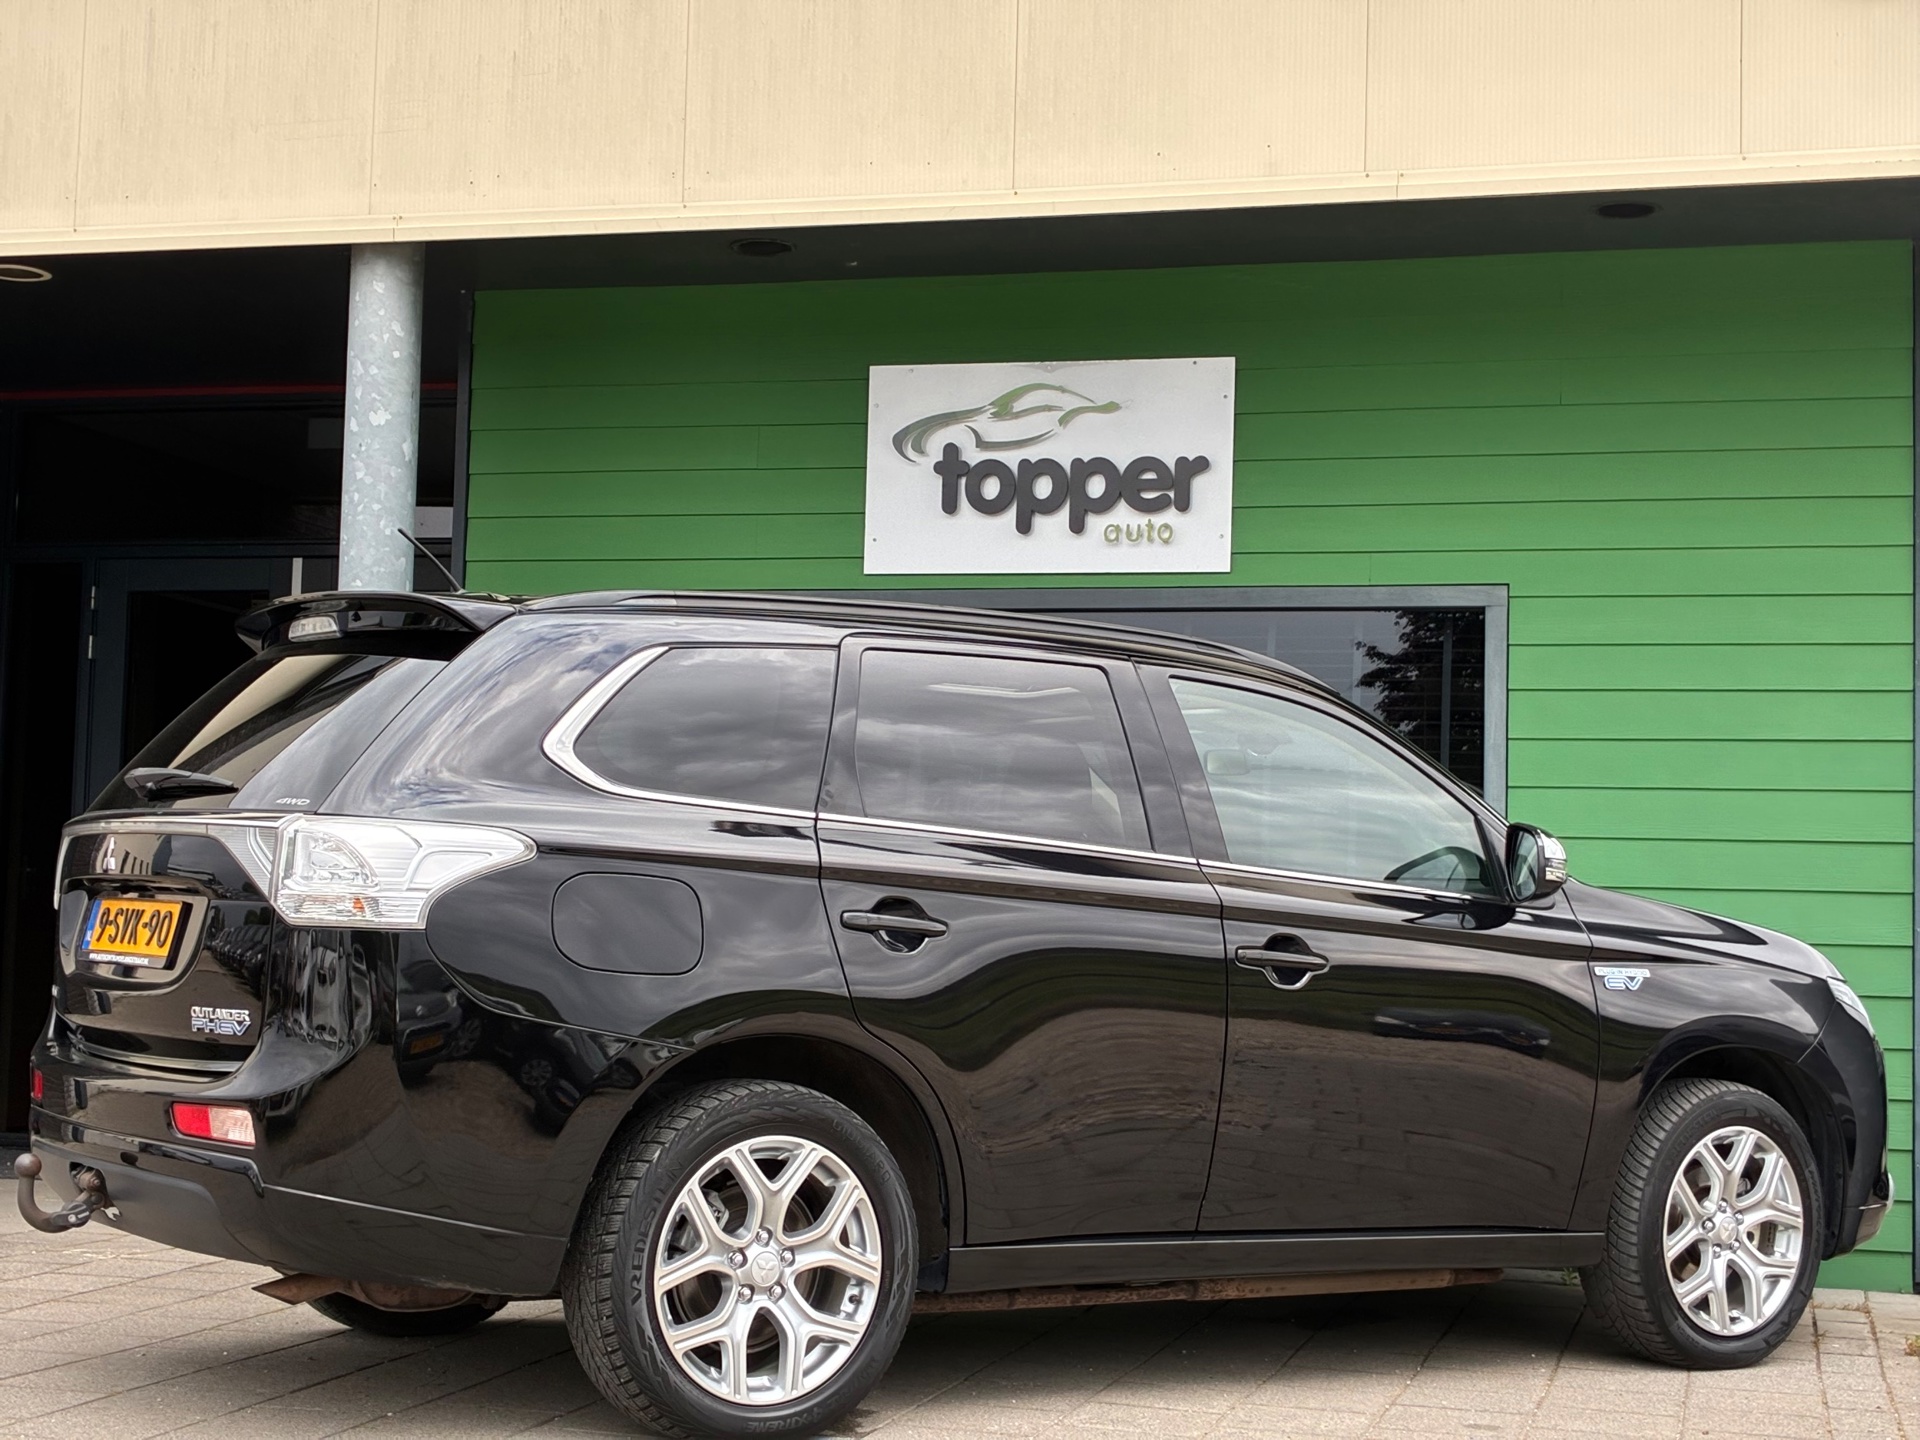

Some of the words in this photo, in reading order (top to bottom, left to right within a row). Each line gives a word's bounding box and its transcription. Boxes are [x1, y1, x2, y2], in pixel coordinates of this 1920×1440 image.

[933, 442, 1210, 535] topper
[1103, 518, 1173, 543] auto
[275, 797, 311, 806] 4WD
[95, 906, 174, 949] 9-SVK-90
[1604, 975, 1644, 991] EV
[190, 1006, 251, 1022] OUTLANDER
[191, 1017, 252, 1036] PHEV
